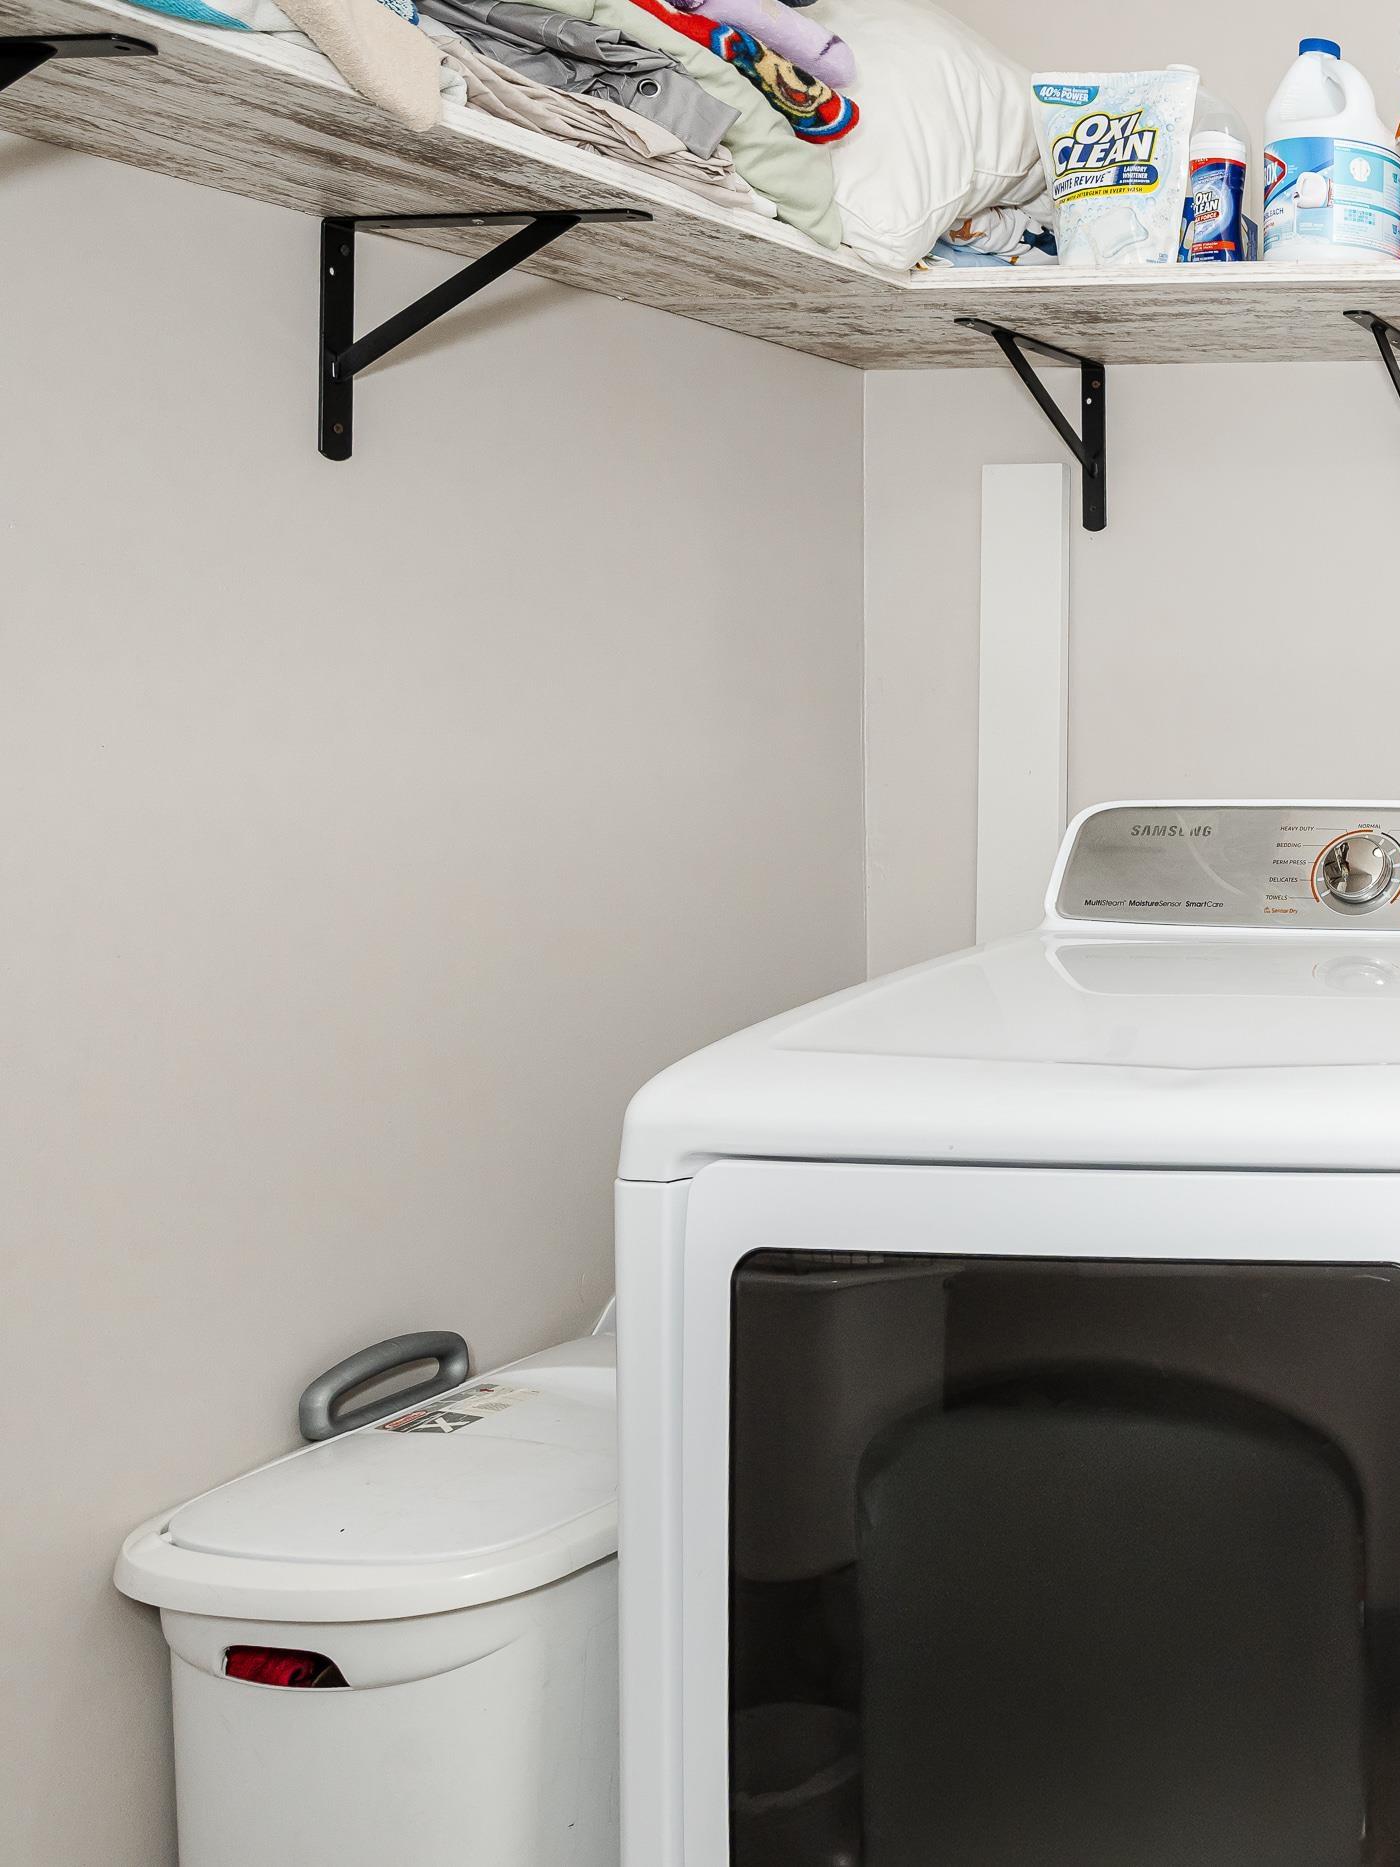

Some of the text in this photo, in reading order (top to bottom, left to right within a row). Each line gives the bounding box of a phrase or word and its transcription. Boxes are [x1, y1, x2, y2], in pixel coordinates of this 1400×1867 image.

[1040, 86, 1060, 97] 40%
[1061, 90, 1089, 102] POWER
[1076, 112, 1141, 144] OXI
[1053, 131, 1155, 175] CLEAN
[1054, 173, 1106, 196] WHITE REVIVE
[1076, 189, 1102, 199] DETERGENT
[1195, 191, 1213, 206] OXI
[1128, 899, 1182, 908] MoistureSensor
[1185, 900, 1224, 908] SmartCare
